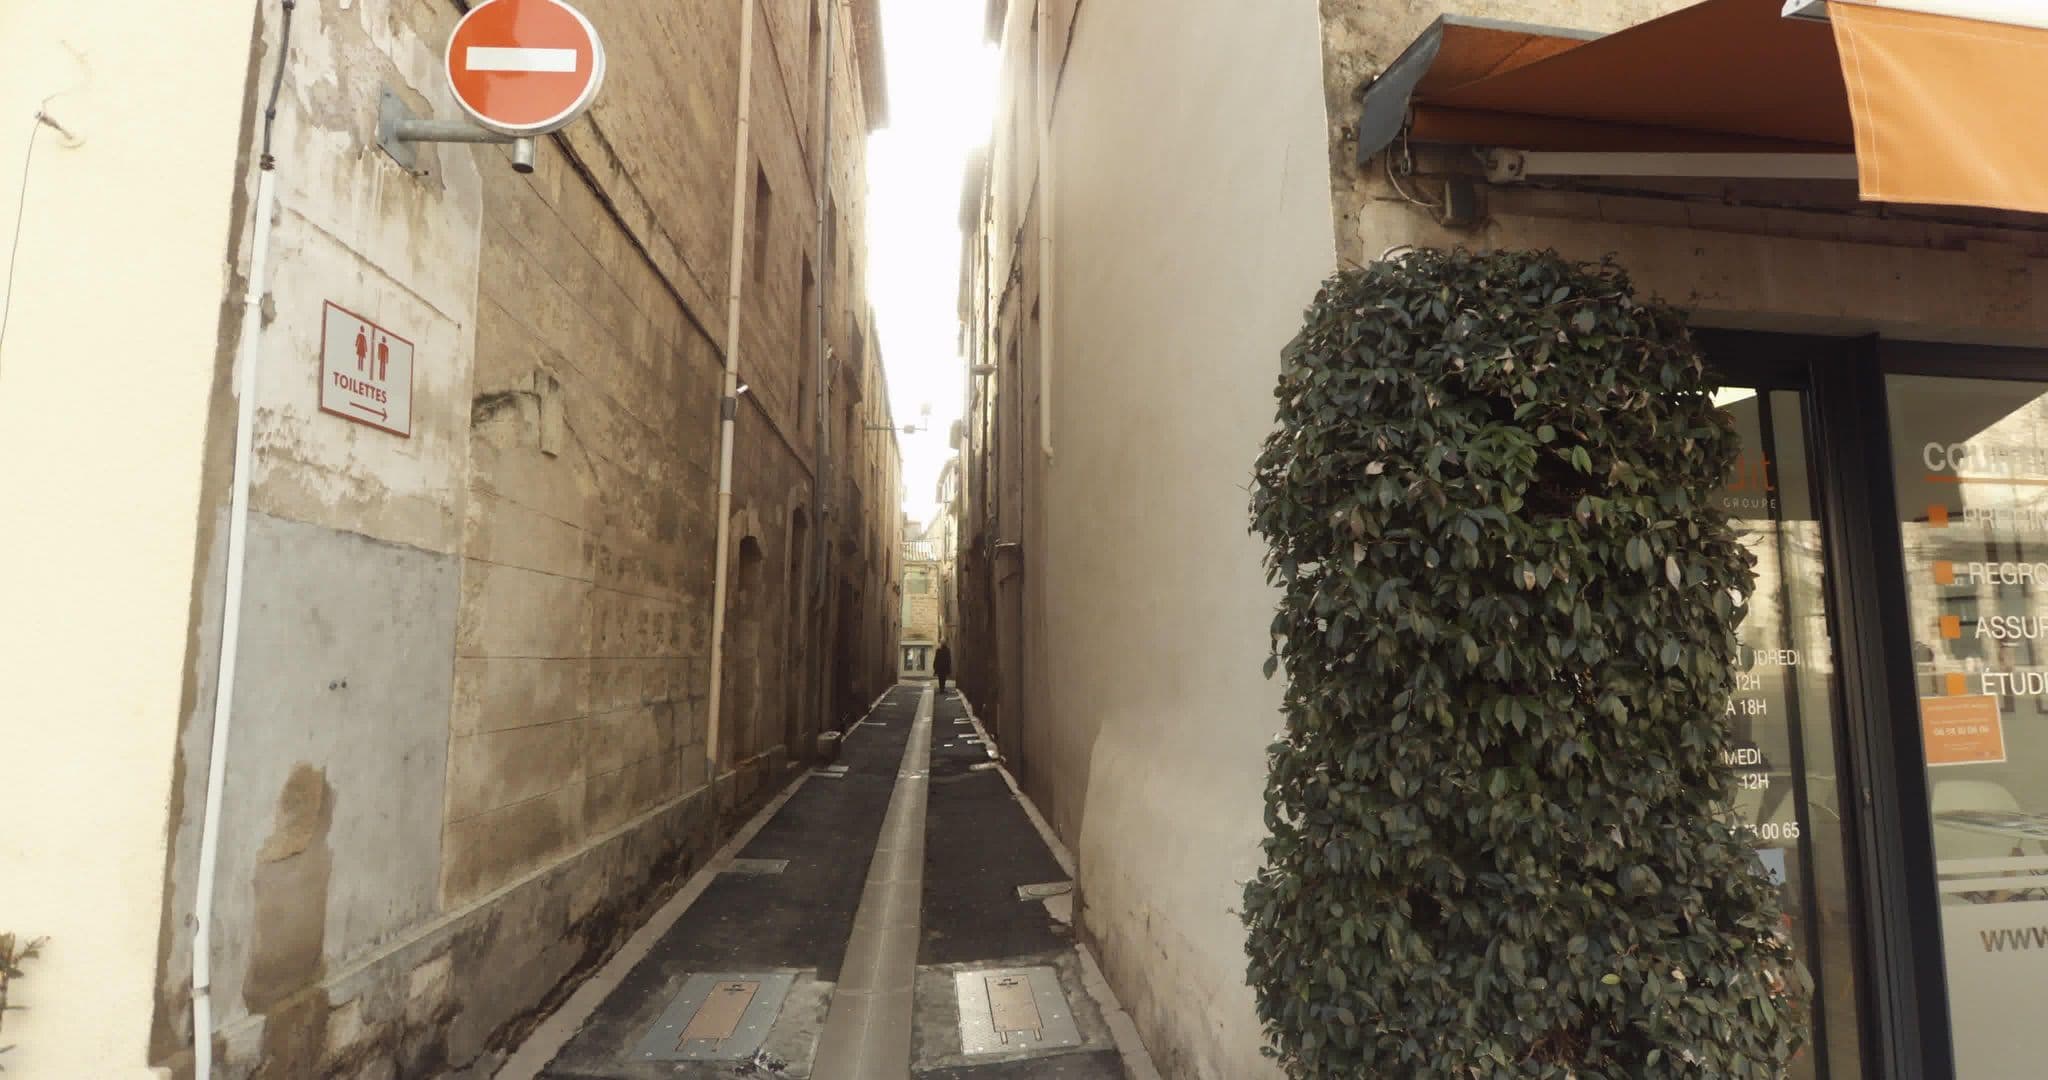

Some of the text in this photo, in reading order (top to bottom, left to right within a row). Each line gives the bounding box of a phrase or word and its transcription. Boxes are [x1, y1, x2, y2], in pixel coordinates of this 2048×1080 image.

[332, 371, 388, 404] TOILETTES
[1740, 698, 1767, 715] 18H
[1741, 773, 1769, 789] 12H
[1762, 823, 1779, 839] 00
[1783, 822, 1800, 838] 65
